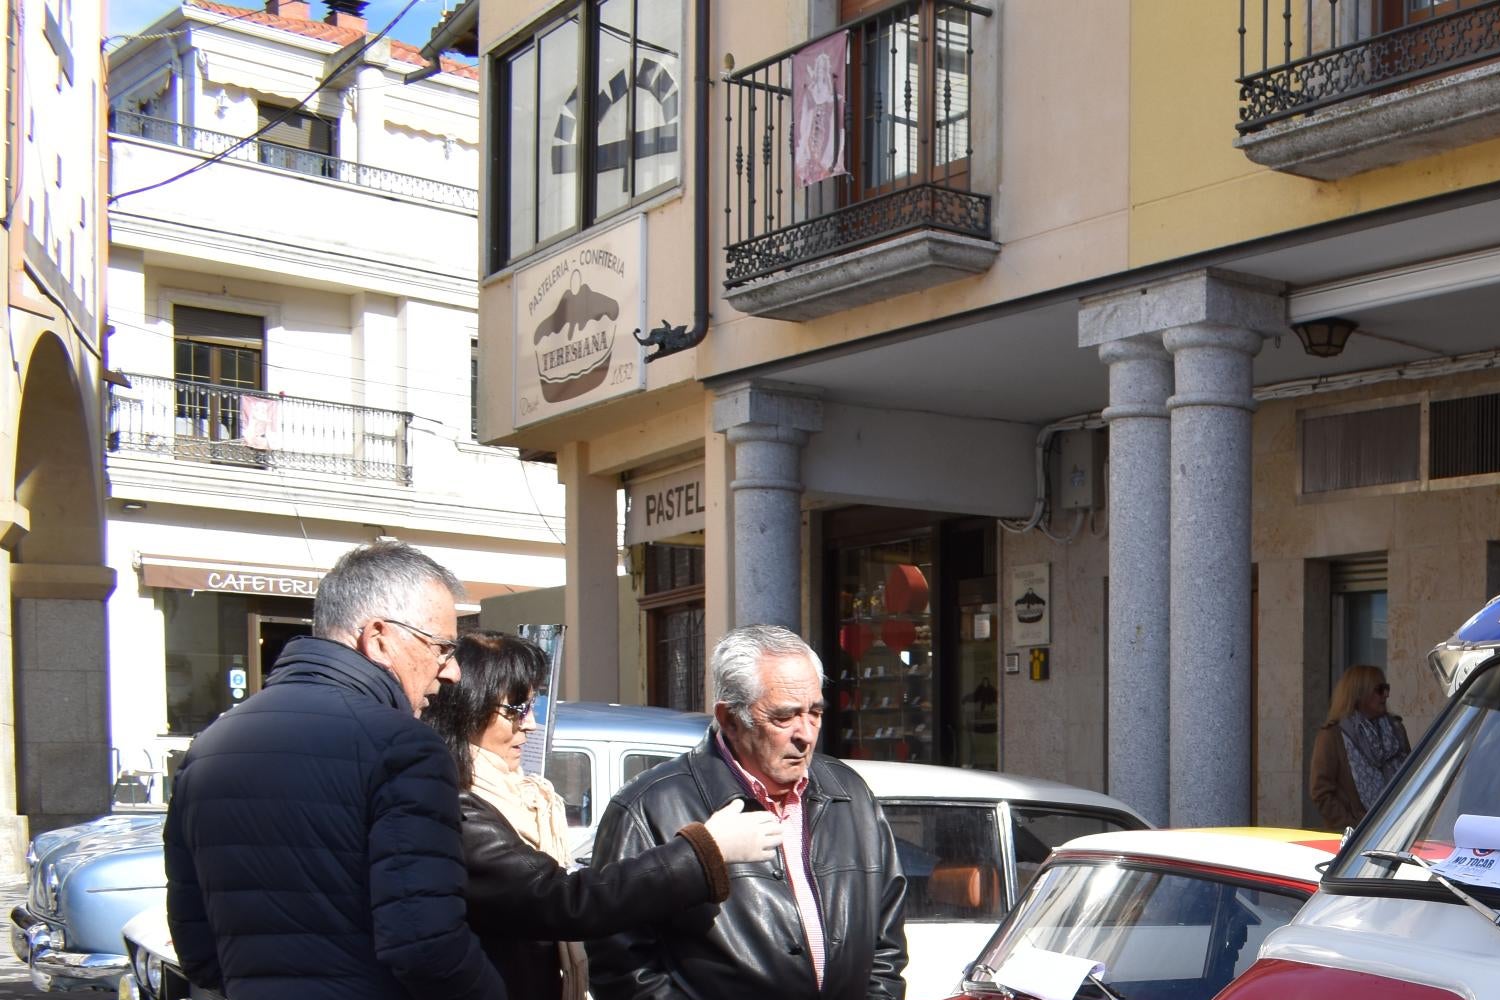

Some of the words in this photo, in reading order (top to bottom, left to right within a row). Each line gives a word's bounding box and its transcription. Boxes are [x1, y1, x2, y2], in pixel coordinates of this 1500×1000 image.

[579, 250, 625, 279] CONFITERIA
[542, 330, 609, 373] TERESIANA
[208, 572, 319, 595] CAFETERI
[1467, 857, 1495, 869] TOCAR
